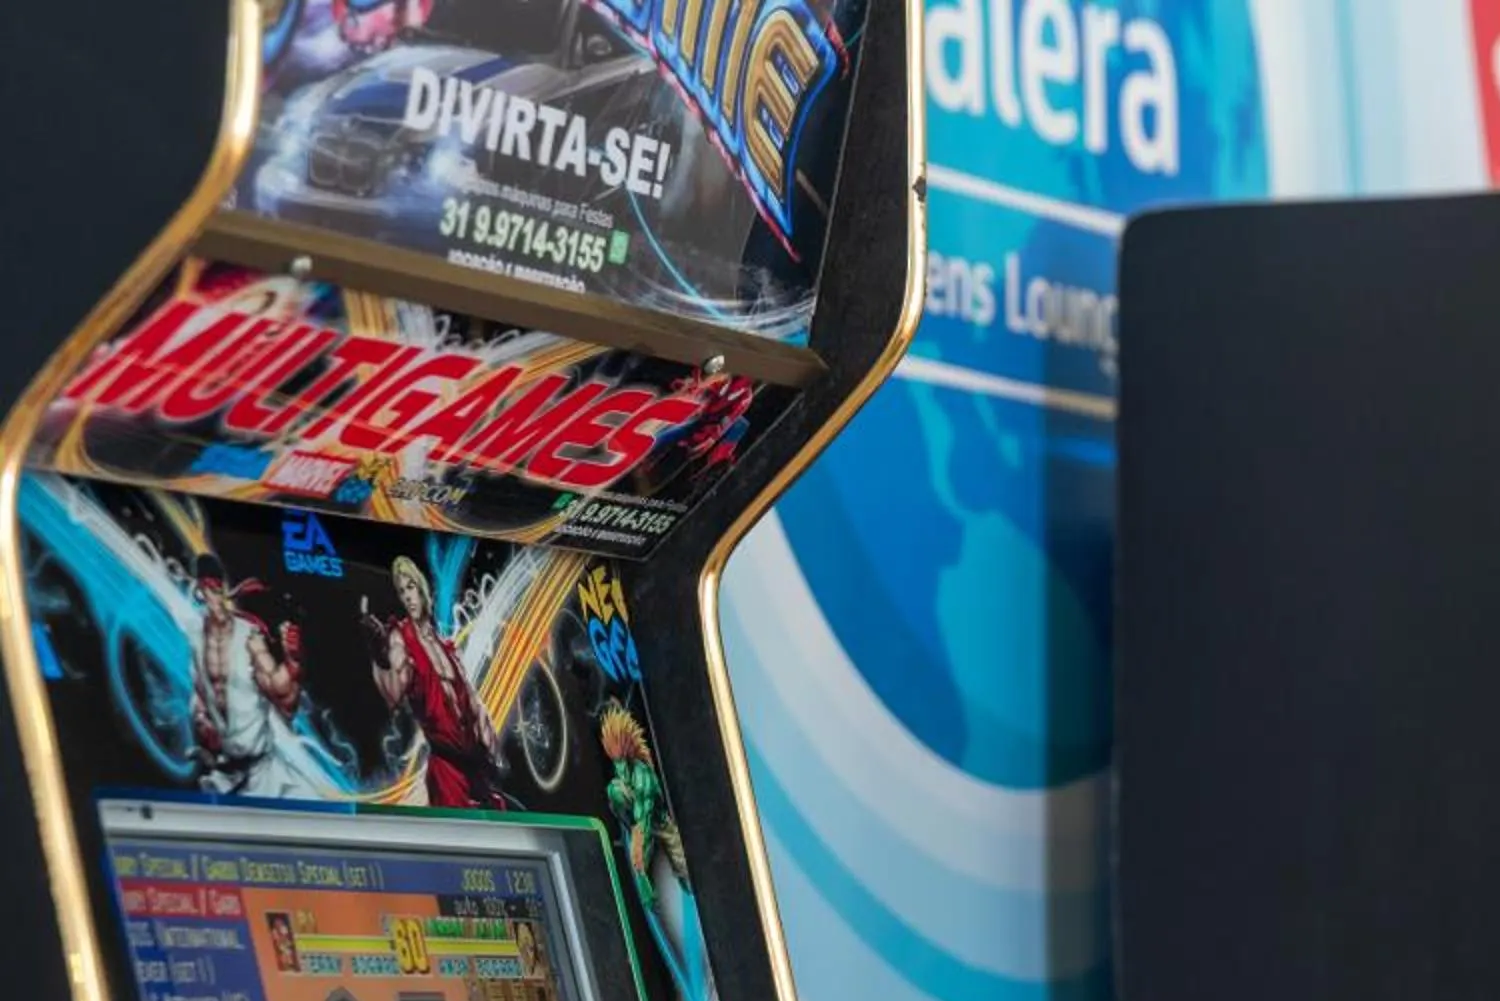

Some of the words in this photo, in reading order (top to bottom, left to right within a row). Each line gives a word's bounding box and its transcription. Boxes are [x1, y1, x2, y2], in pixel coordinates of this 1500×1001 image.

[403, 66, 670, 199] DIVIRTA-SE!
[439, 196, 471, 238] 31
[473, 204, 607, 273] 9.9714-3155
[64, 301, 704, 488] MULTIGAMES
[283, 550, 344, 578] GAMES
